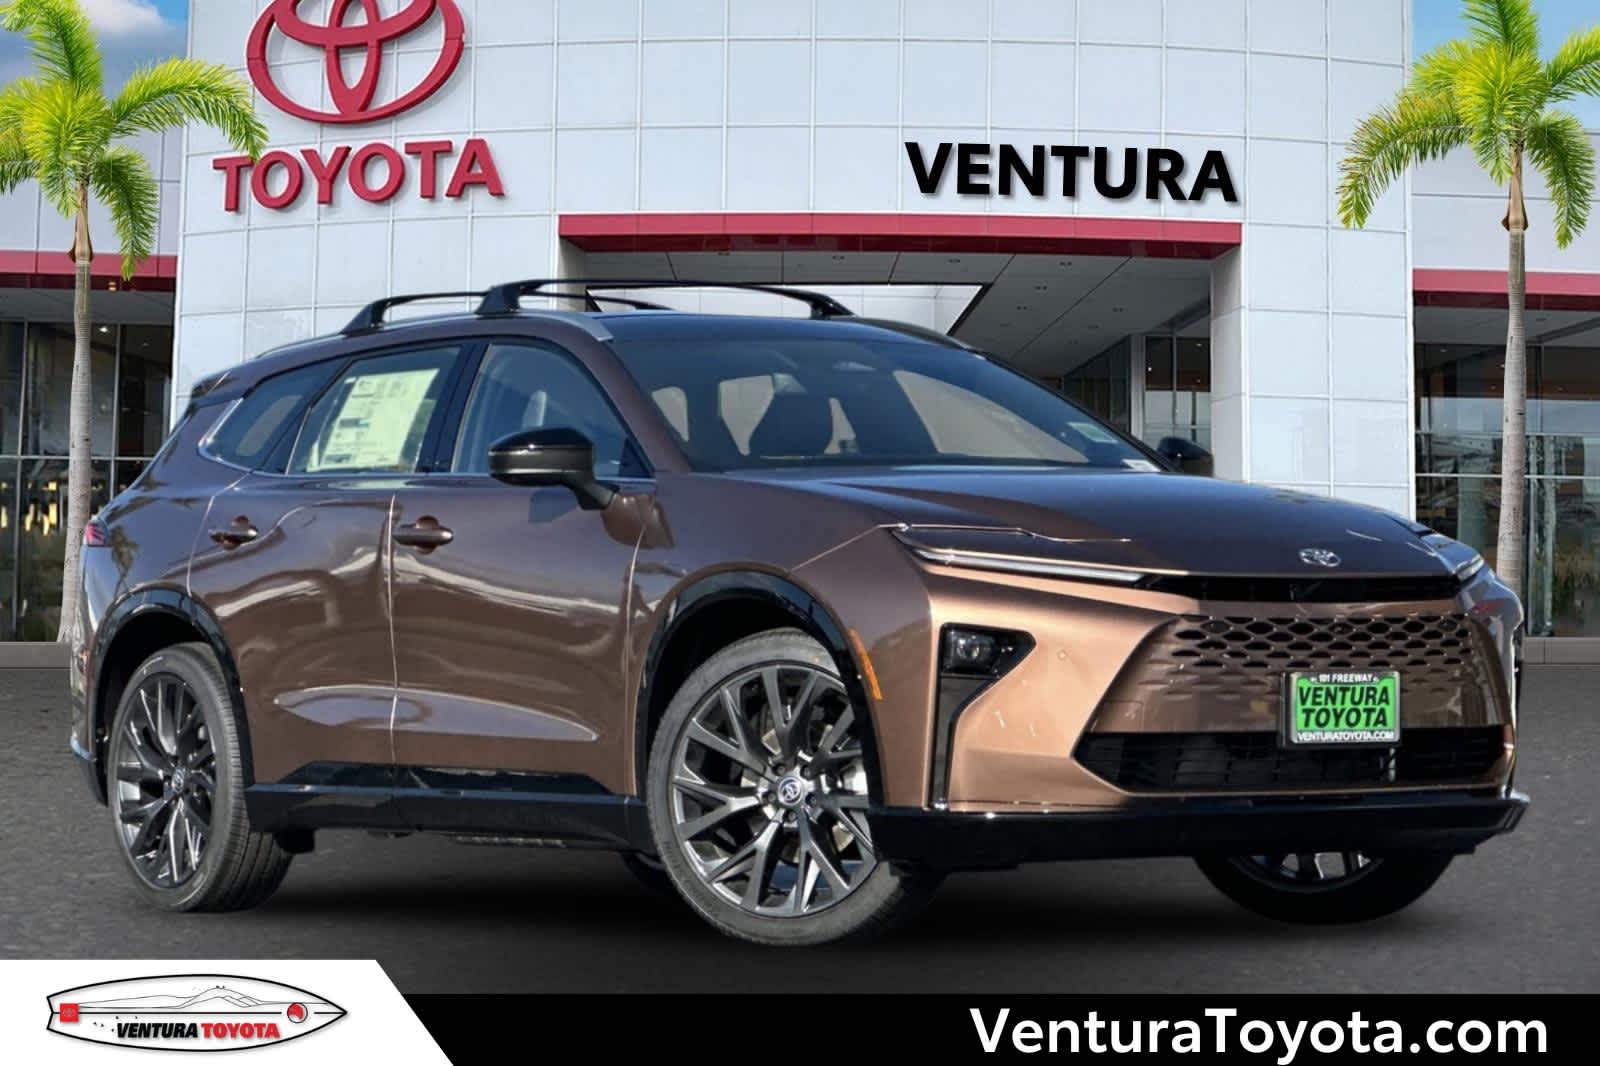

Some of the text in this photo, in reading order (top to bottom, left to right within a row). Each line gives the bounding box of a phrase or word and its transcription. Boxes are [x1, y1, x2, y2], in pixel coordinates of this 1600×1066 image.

[213, 138, 505, 212] TOYOTA
[904, 141, 1238, 203] VENTURA
[1332, 673, 1374, 683] FREEWAY
[1299, 686, 1389, 706] VENTURA
[1302, 707, 1388, 728] TOYOTA
[1297, 731, 1395, 741] VENTURATOYOTA.COM
